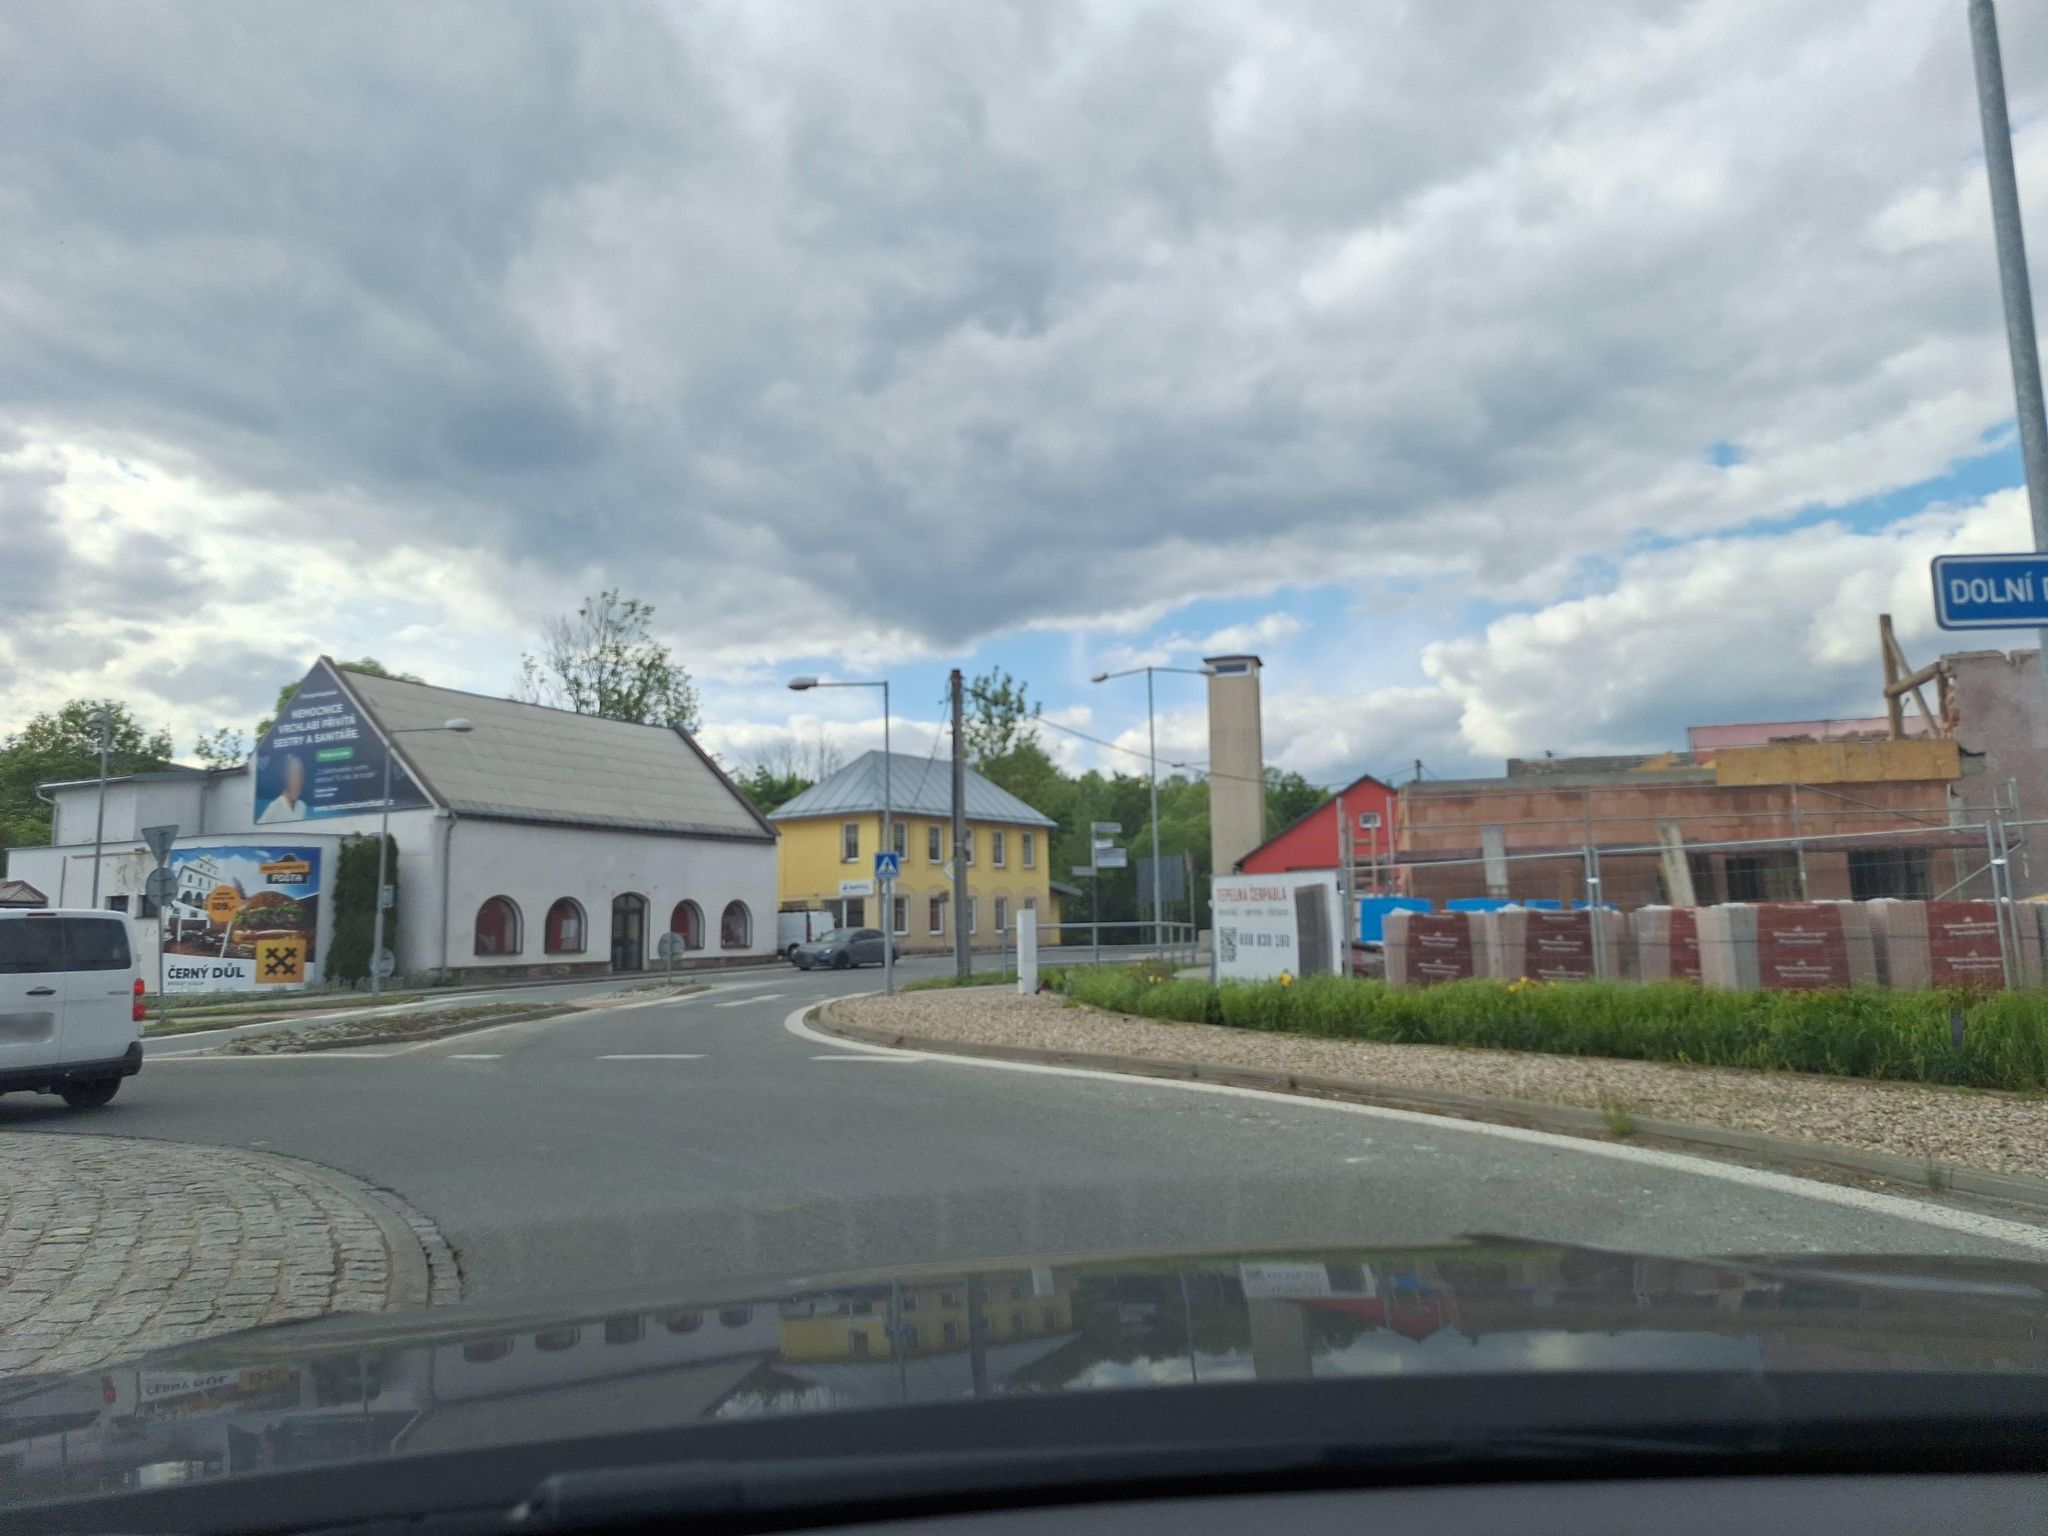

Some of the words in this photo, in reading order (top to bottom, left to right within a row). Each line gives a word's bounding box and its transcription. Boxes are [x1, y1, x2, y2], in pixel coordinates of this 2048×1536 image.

[1950, 571, 2036, 605] DOLNÍ
[291, 703, 344, 719] NEMOCNICE
[273, 736, 304, 748] SESTRY
[305, 735, 313, 744] A
[168, 963, 209, 979] ČERNÝ
[212, 962, 246, 979] DŮL
